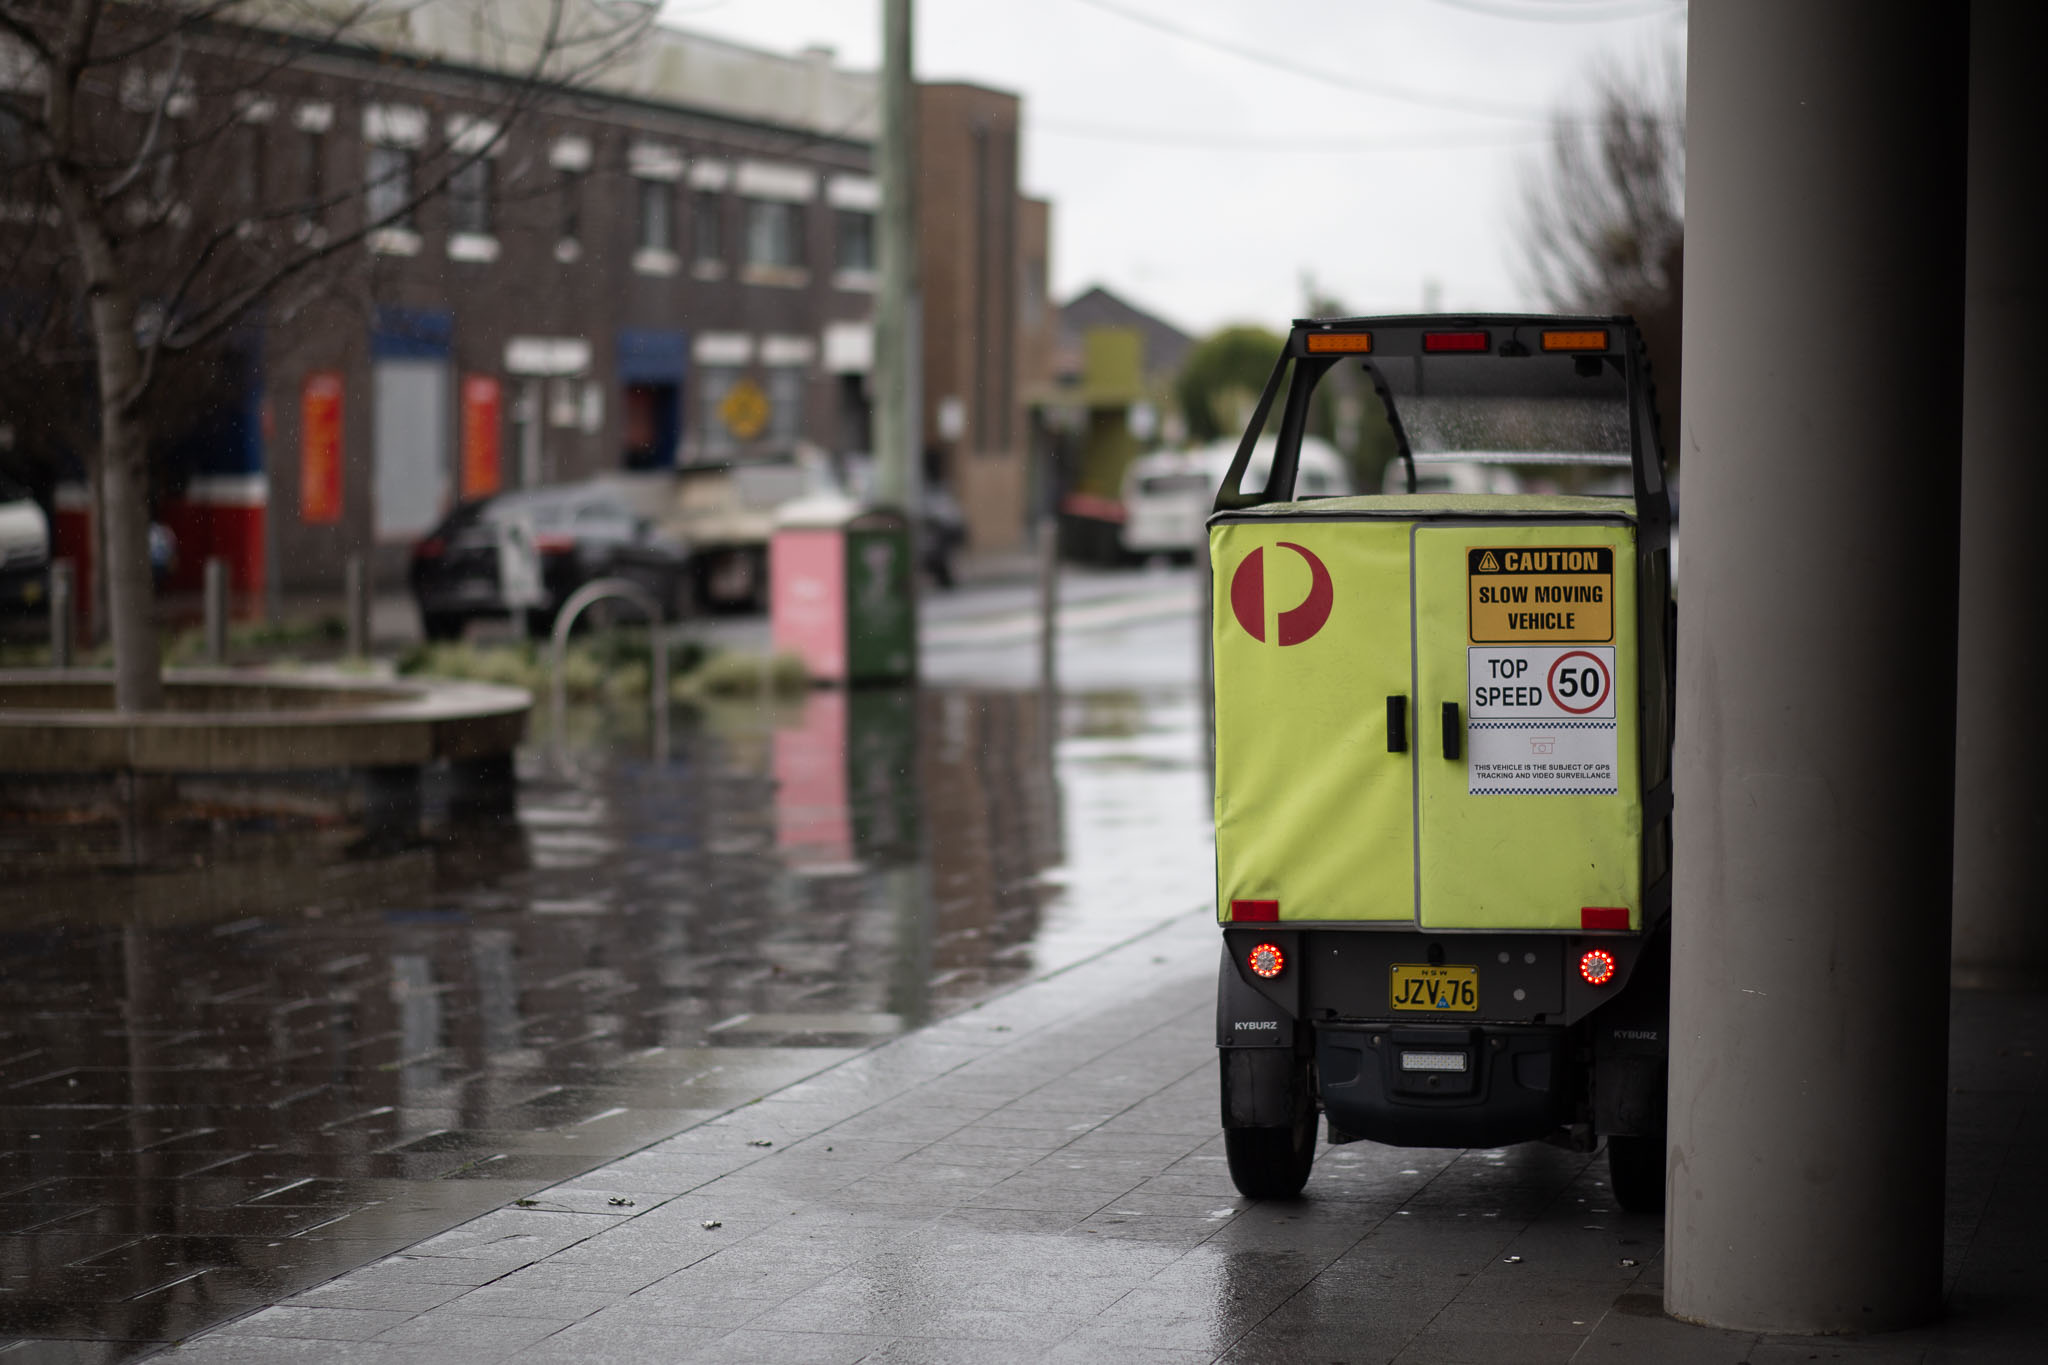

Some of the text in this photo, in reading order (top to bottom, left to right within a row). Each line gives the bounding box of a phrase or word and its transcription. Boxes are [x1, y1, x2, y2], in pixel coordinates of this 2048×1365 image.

[1504, 551, 1599, 572] CAUTION
[1479, 585, 1603, 604] SLOW MOVING
[1508, 612, 1576, 630] VEHICLE
[1488, 658, 1528, 679] TOP
[1558, 667, 1600, 698] 50
[1475, 686, 1543, 707] SPEED
[1395, 979, 1474, 1006] JZV 76
[1234, 1021, 1278, 1031] KYBURZ
[1614, 1030, 1657, 1040] KYBURZ
